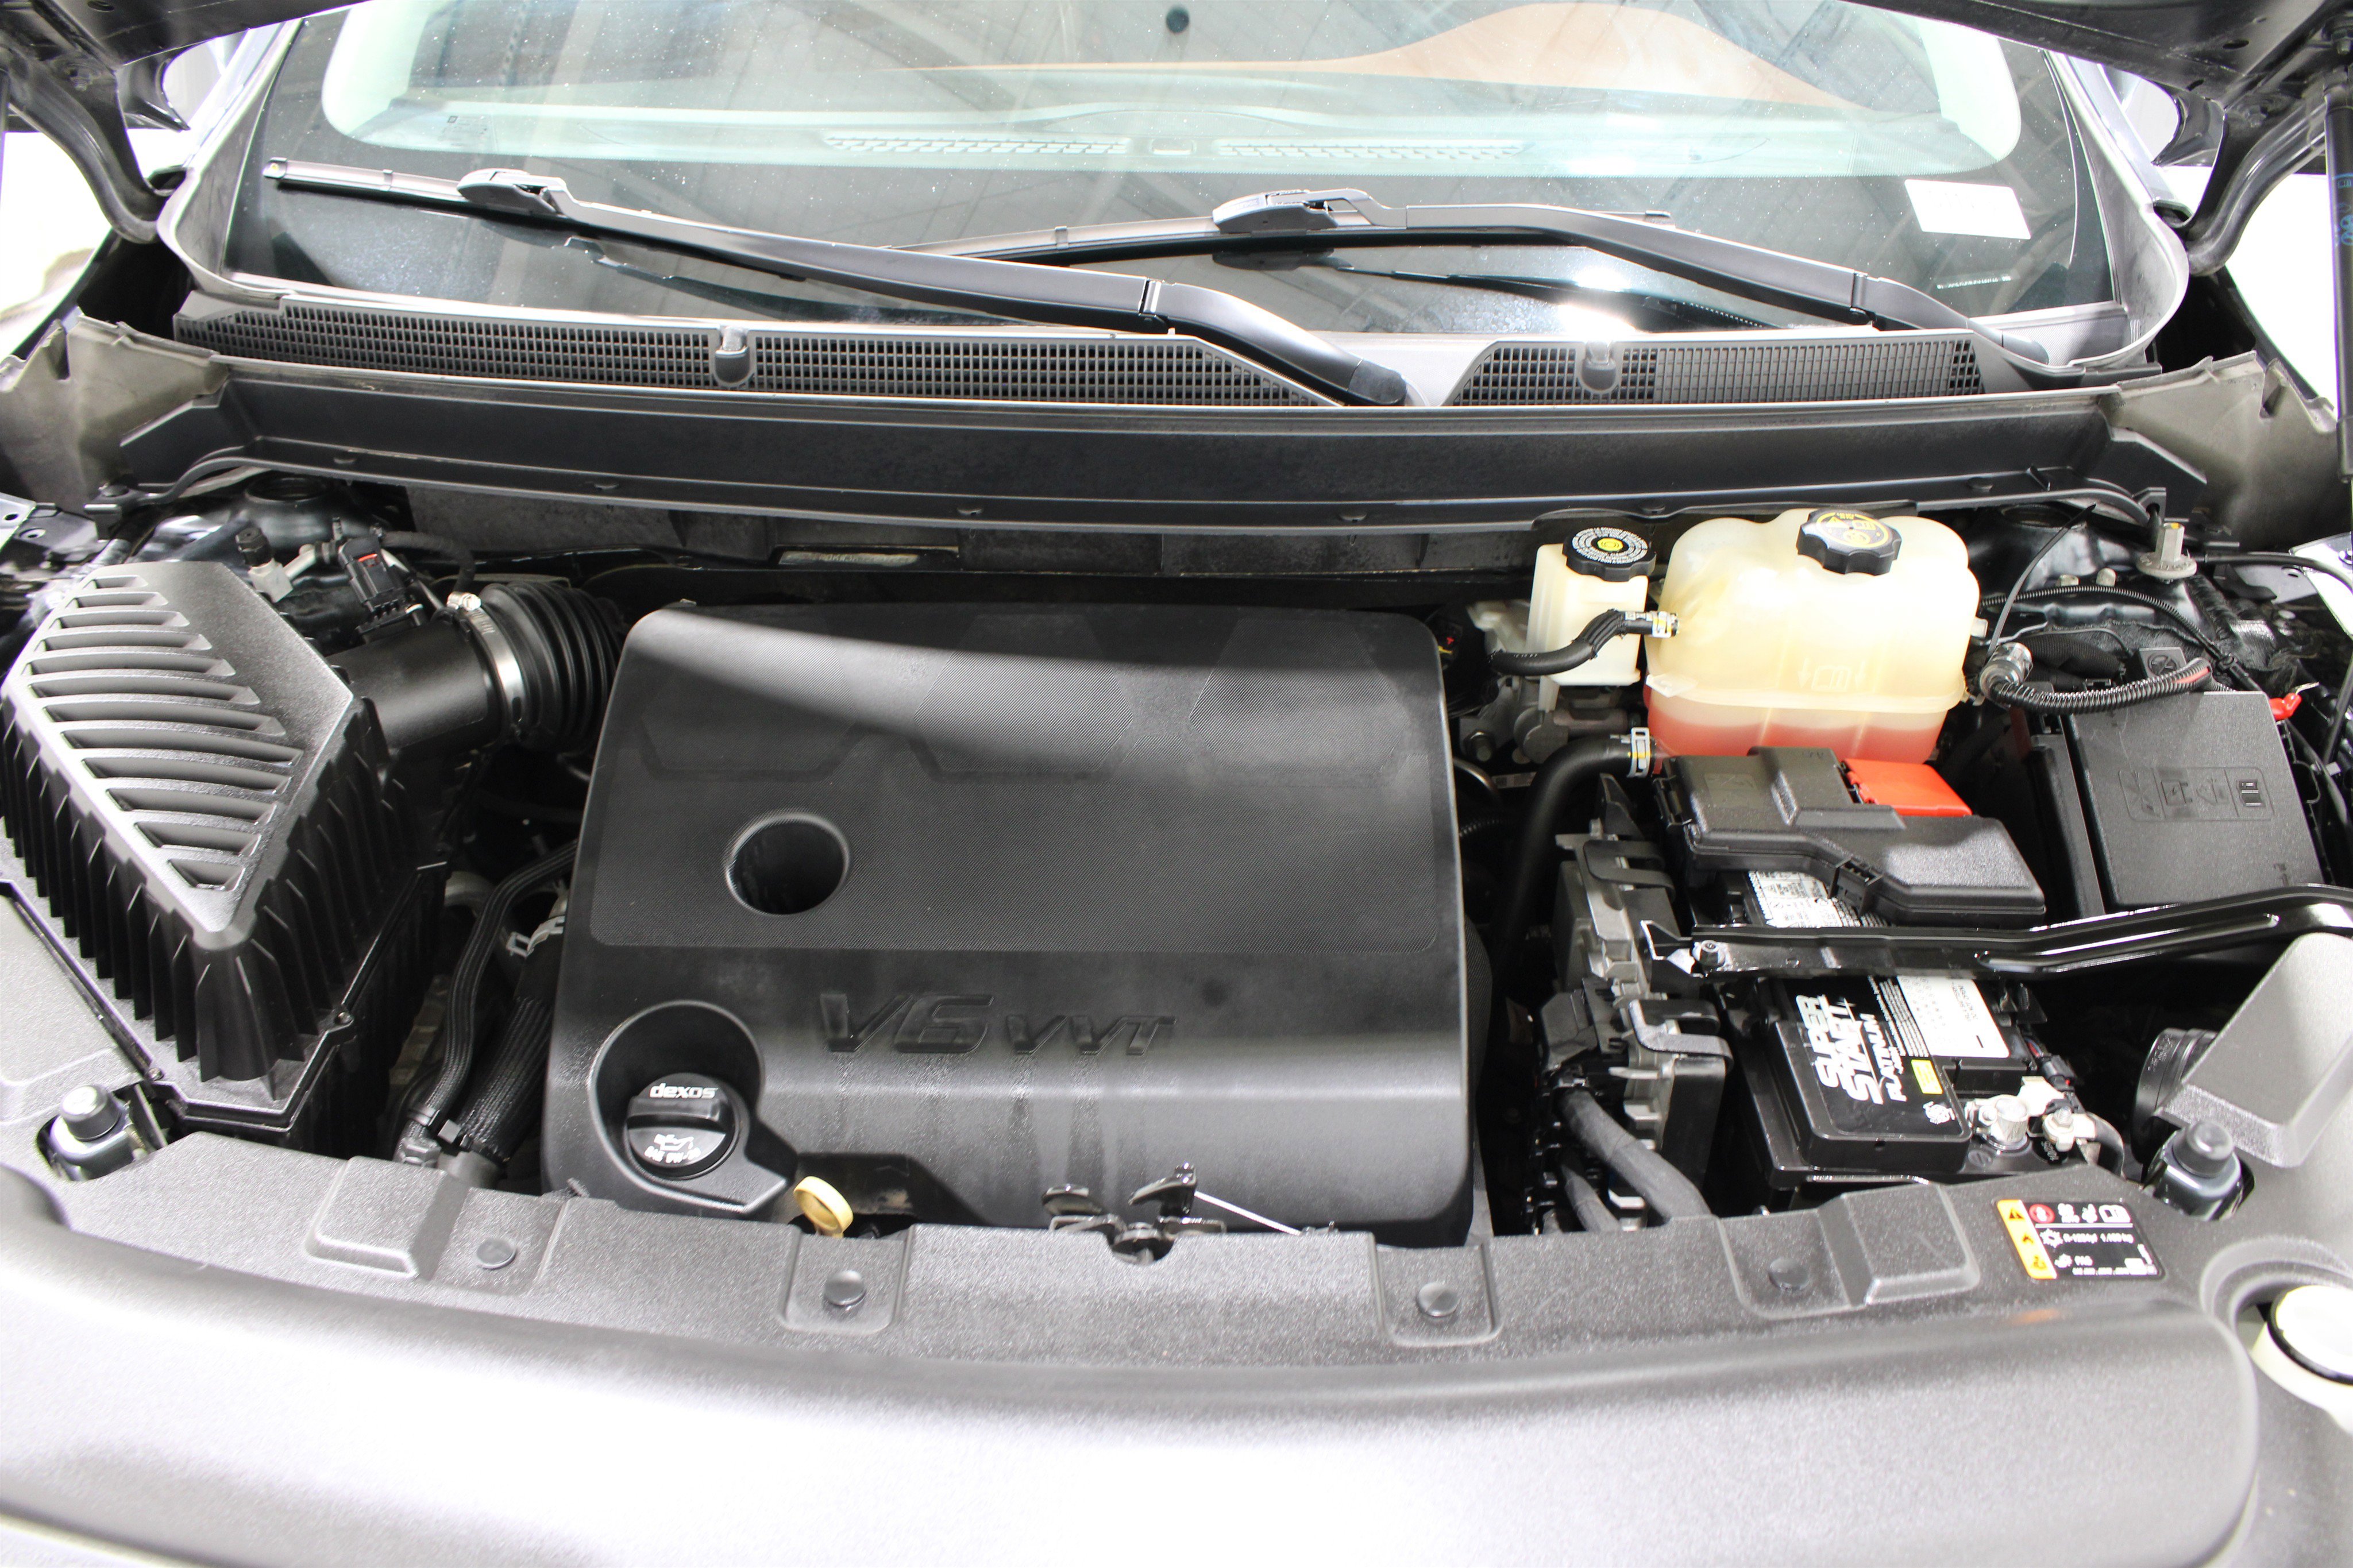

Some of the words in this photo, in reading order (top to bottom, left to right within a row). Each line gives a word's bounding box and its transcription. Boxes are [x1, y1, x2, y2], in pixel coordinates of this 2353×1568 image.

[820, 993, 994, 1053] V6
[1005, 1014, 1176, 1056] VVT
[1796, 995, 1839, 1088] SUPER
[1817, 994, 1884, 1104] START
[1860, 1013, 1907, 1102] PLATINUM
[650, 1083, 719, 1099] dexos
